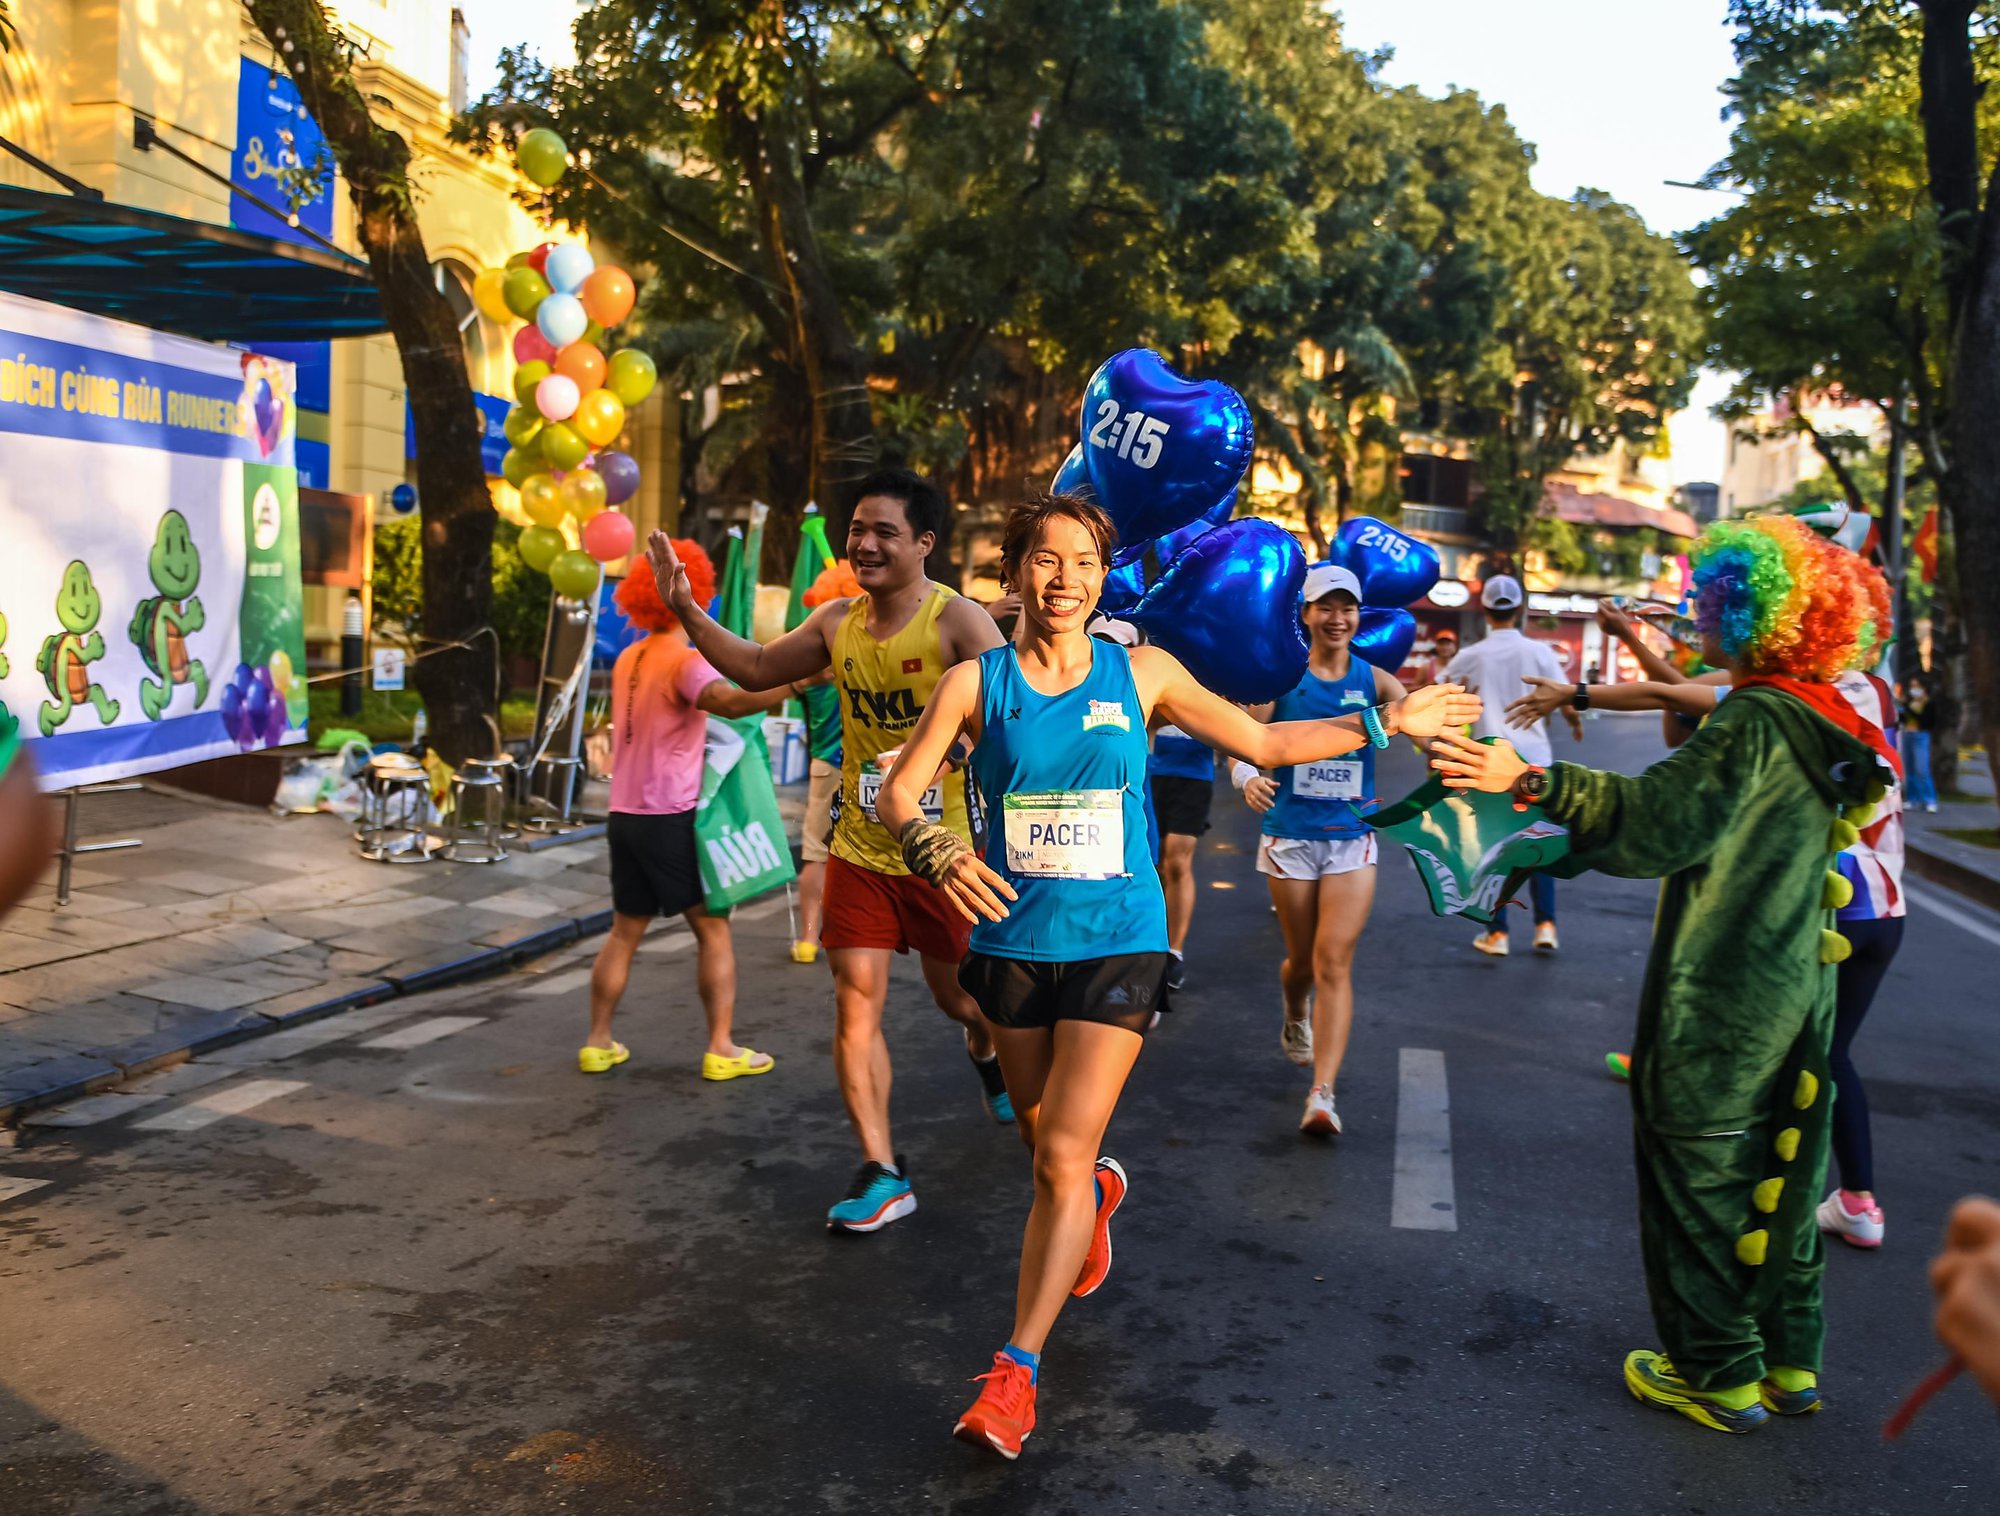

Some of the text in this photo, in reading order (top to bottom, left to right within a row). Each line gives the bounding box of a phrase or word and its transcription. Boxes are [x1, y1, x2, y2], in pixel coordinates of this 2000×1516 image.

[1089, 399, 1171, 470] 2:15
[1356, 525, 1411, 562] 2:15
[1308, 767, 1352, 782] PACER
[1029, 823, 1101, 846] PACER
